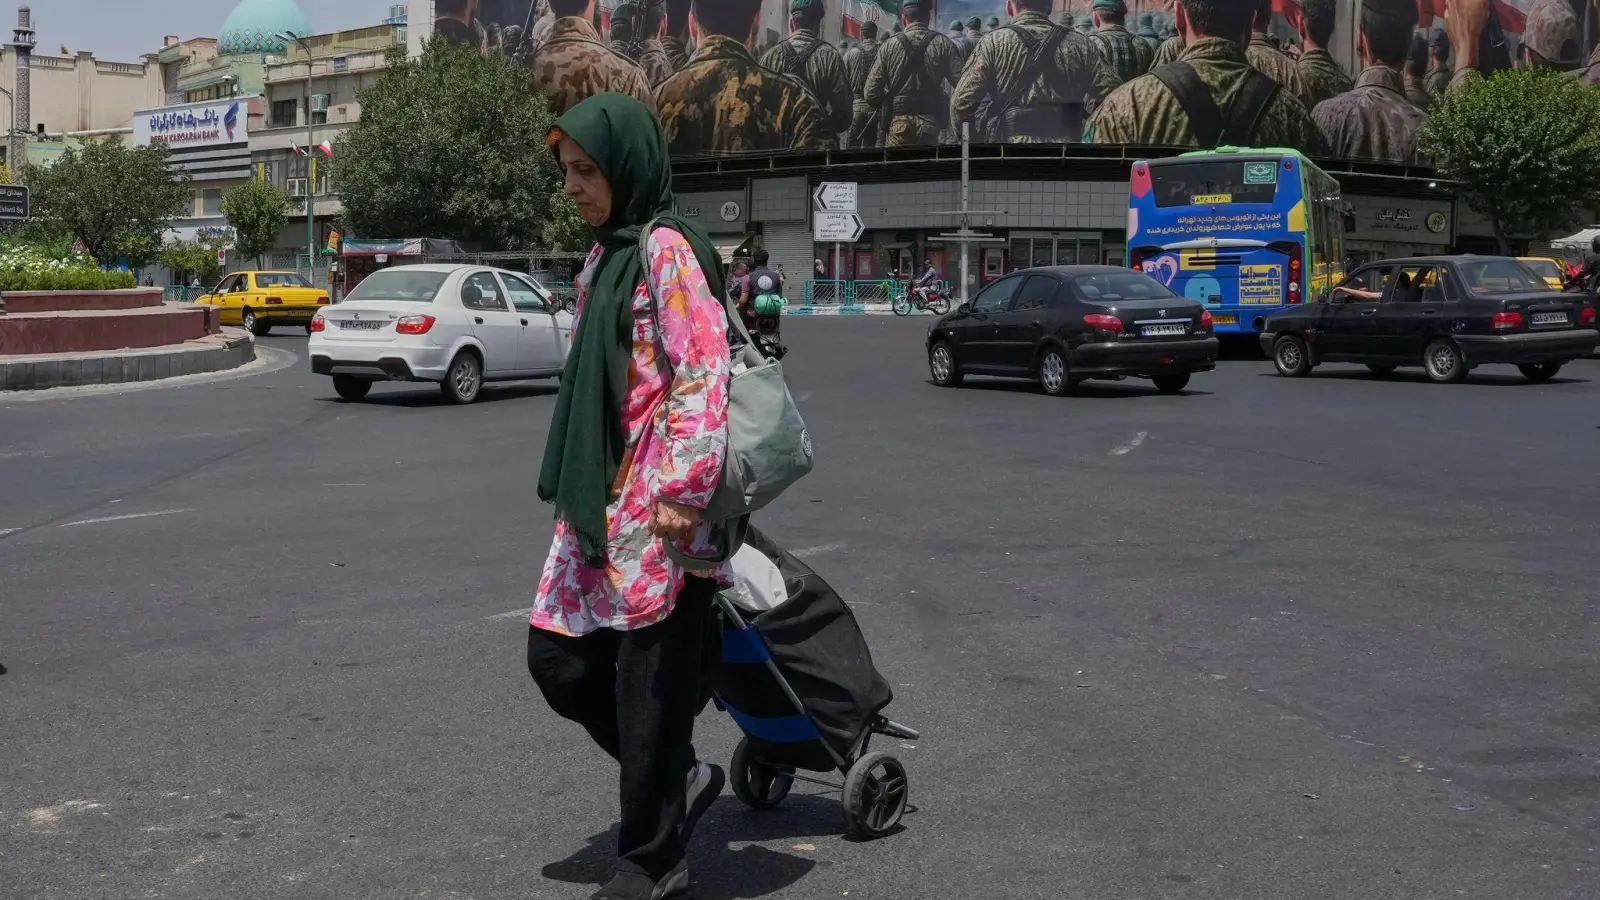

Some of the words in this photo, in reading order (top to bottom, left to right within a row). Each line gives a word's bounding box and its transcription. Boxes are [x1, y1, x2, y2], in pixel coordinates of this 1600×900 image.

[150, 112, 177, 131] کارگران
[177, 109, 197, 129] رفاه
[198, 108, 219, 128] بانک
[202, 129, 220, 140] BANK
[1256, 213, 1270, 222] یکی
[1270, 213, 1281, 221] این
